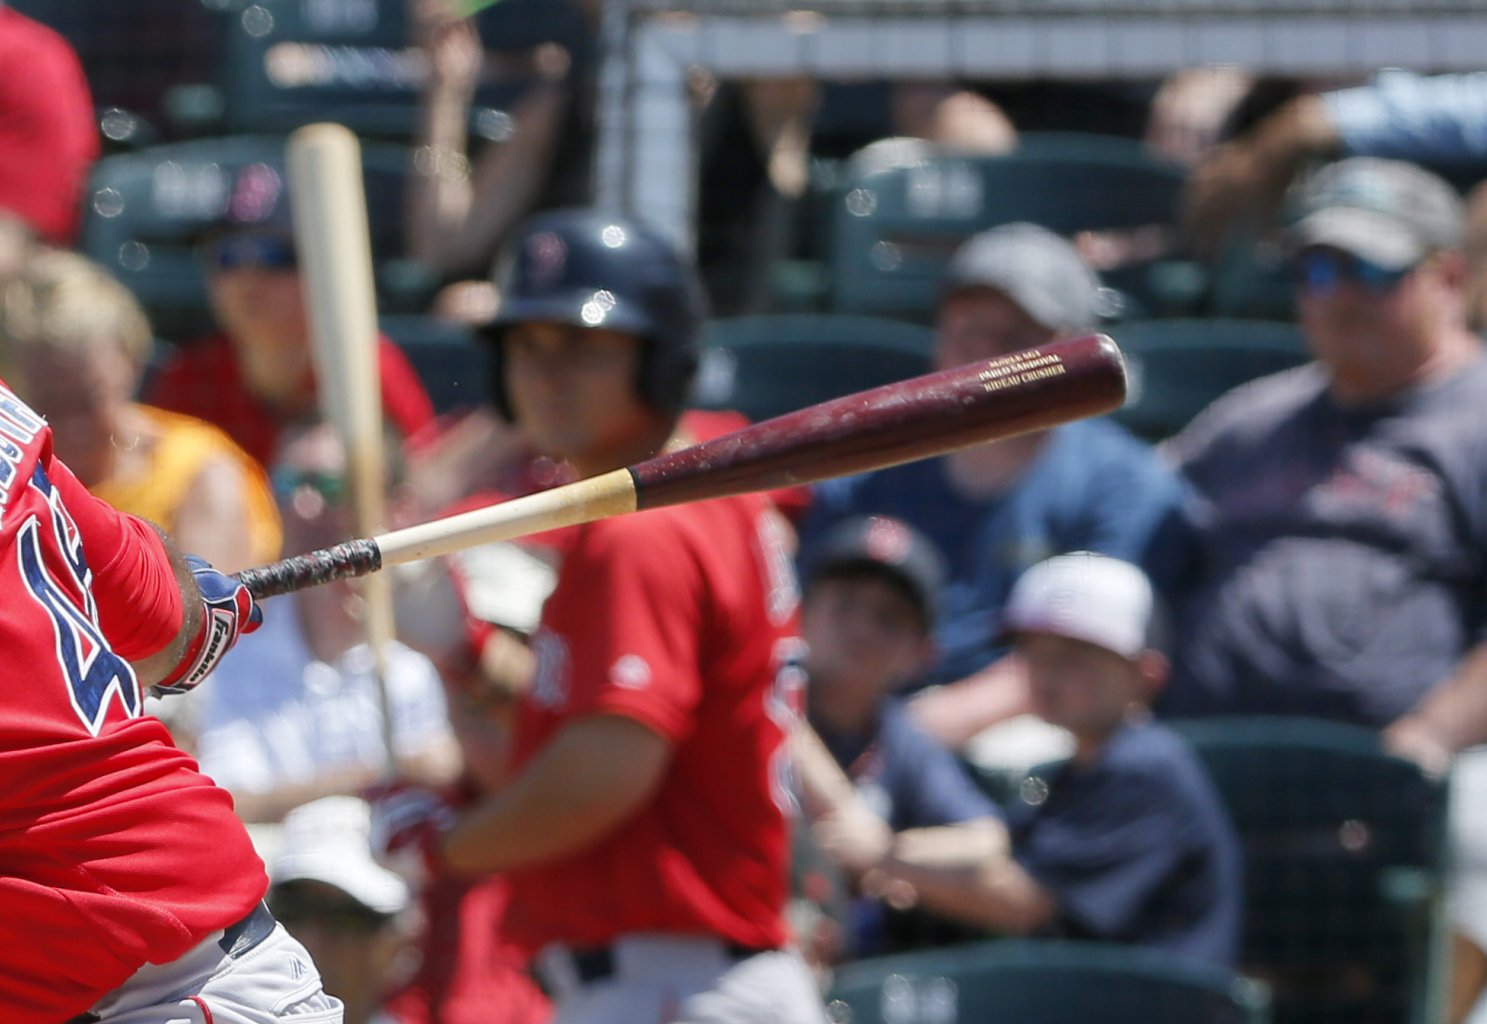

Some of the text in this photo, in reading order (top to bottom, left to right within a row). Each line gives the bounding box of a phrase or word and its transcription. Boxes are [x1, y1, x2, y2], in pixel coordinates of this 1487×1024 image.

[983, 363, 1066, 393] RIDEAU CRUSHER
[1010, 354, 1062, 373] SANDOVAL
[189, 614, 230, 683] Franklin
